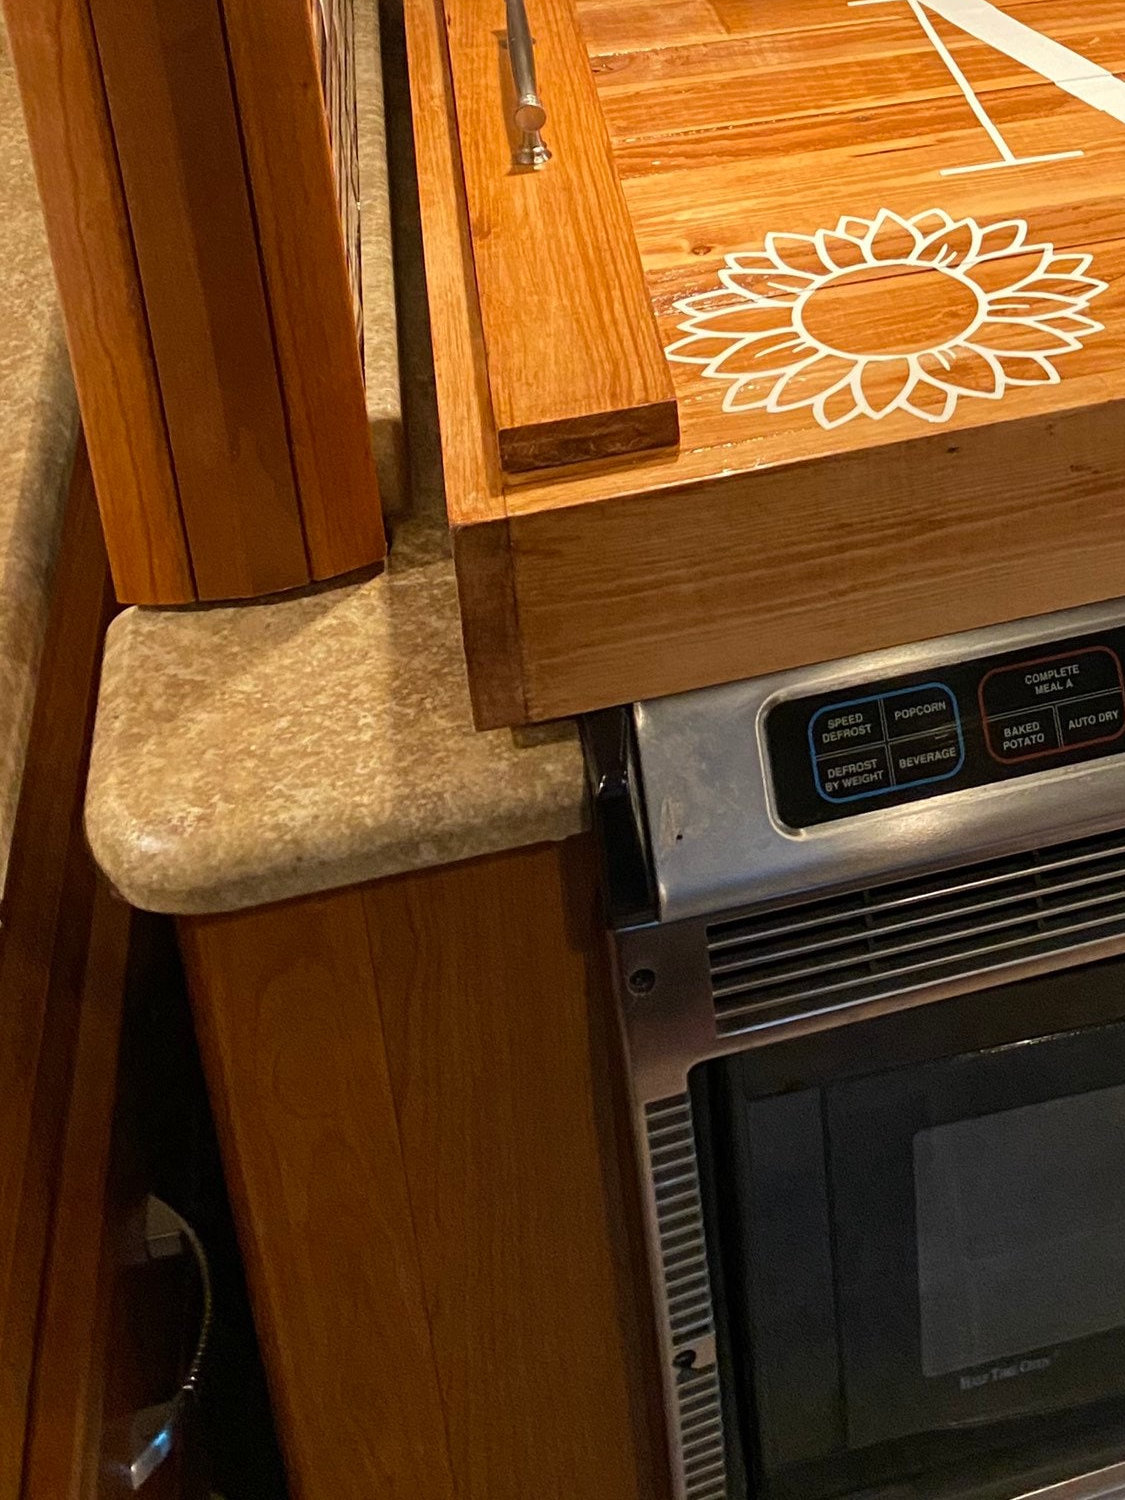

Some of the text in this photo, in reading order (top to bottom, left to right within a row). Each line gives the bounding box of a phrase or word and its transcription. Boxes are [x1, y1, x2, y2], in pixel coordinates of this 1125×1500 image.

[1024, 664, 1080, 686] COMPLETE
[1034, 682, 1064, 696] MEAL
[893, 701, 947, 721] POPCORN
[1068, 710, 1119, 731] AUTO DRY
[827, 713, 864, 731] SPEED
[1003, 721, 1041, 739] BAKED
[821, 724, 873, 744] DEFROST
[1003, 733, 1045, 751] POTATO
[898, 747, 957, 770] BEVERAGE
[827, 759, 878, 779] DEFROST
[824, 770, 885, 793] BY WEIGHT
